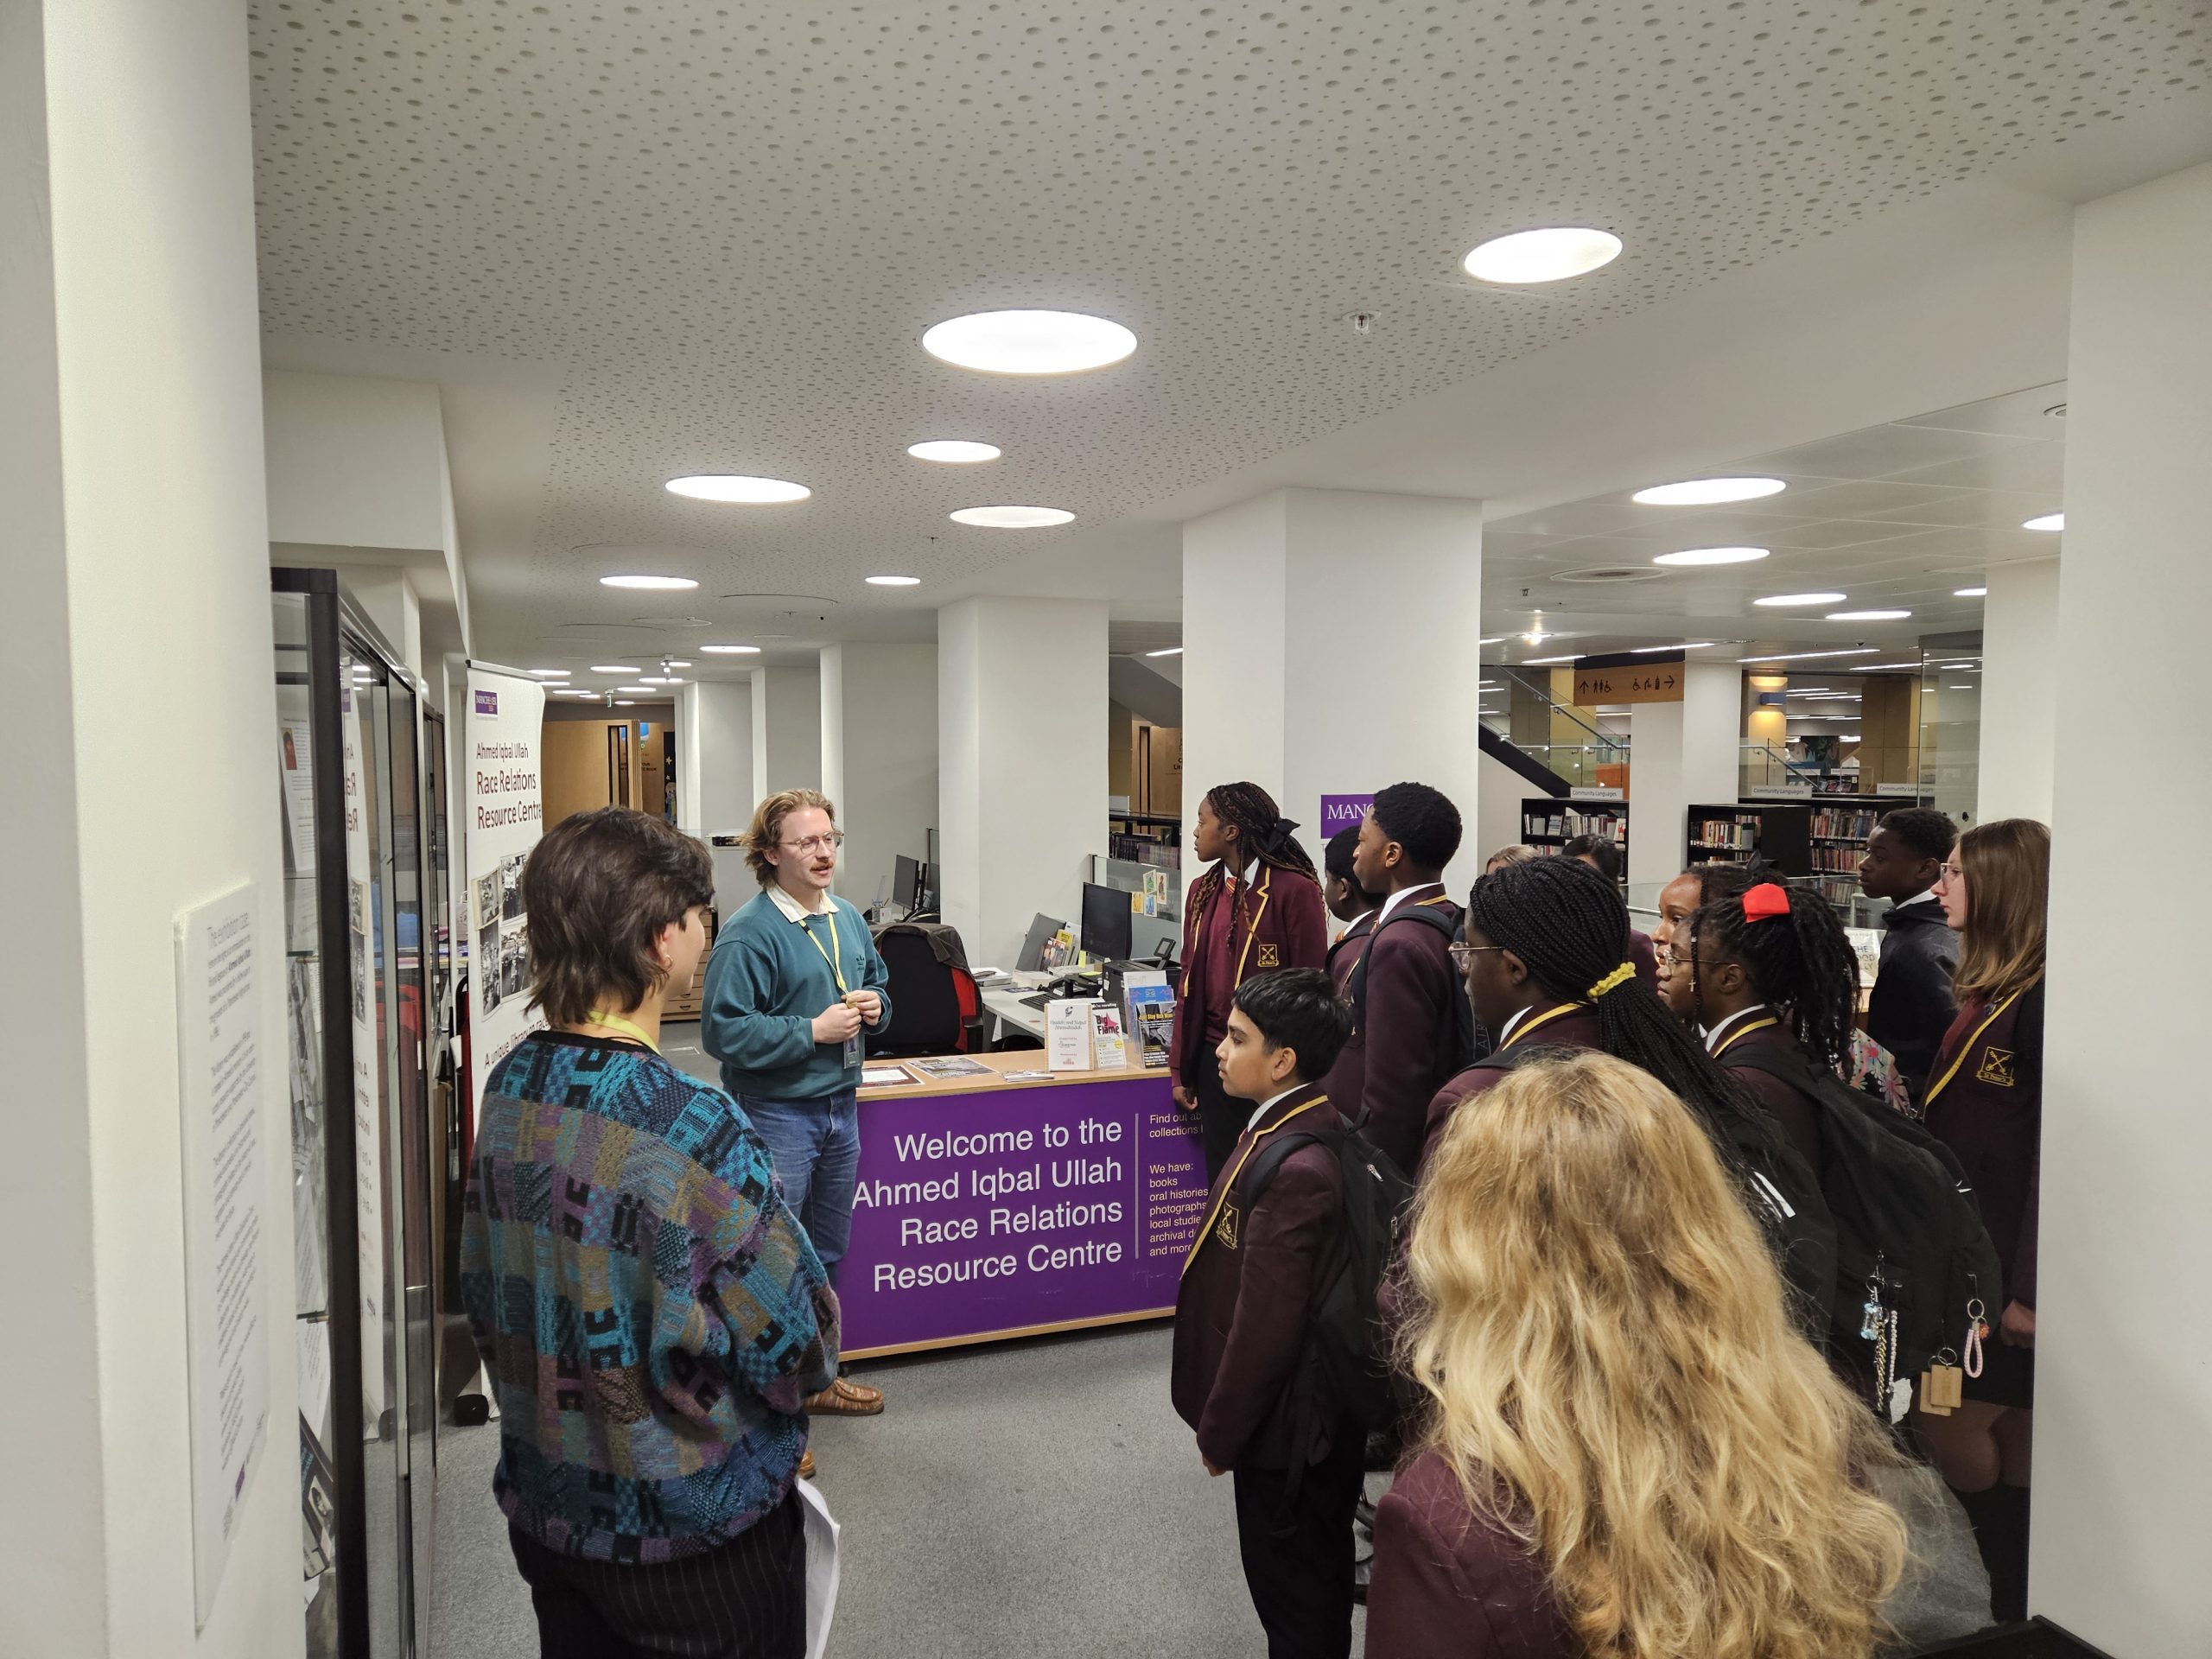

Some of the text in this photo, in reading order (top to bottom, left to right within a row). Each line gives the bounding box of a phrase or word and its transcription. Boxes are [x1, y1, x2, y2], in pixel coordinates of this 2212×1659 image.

[476, 741, 529, 762] Ahmed Iqbal Ullah
[477, 768, 536, 795] Race Relations
[1753, 787, 1780, 796] Community
[478, 804, 517, 830] Resource
[1096, 1014, 1109, 1027] Big
[1097, 1026, 1120, 1035] Flame
[492, 1041, 510, 1064] unique
[1149, 1113, 1171, 1124] Find
[1173, 1112, 1188, 1122] out
[1149, 1126, 1198, 1138] collections
[894, 1118, 1122, 1162] Welcome to the
[1149, 1163, 1194, 1174] We have:
[851, 1156, 1122, 1210] Ahmed Iqbal Ullah
[1149, 1177, 1178, 1188] books
[1149, 1188, 1209, 1202] oral histories
[1149, 1202, 1207, 1217] photographs
[901, 1201, 1122, 1247] Race Relations
[1149, 1215, 1202, 1229] local studie
[1149, 1230, 1185, 1243] archival
[1149, 1245, 1167, 1256] and
[874, 1240, 1122, 1293] Resource Centre
